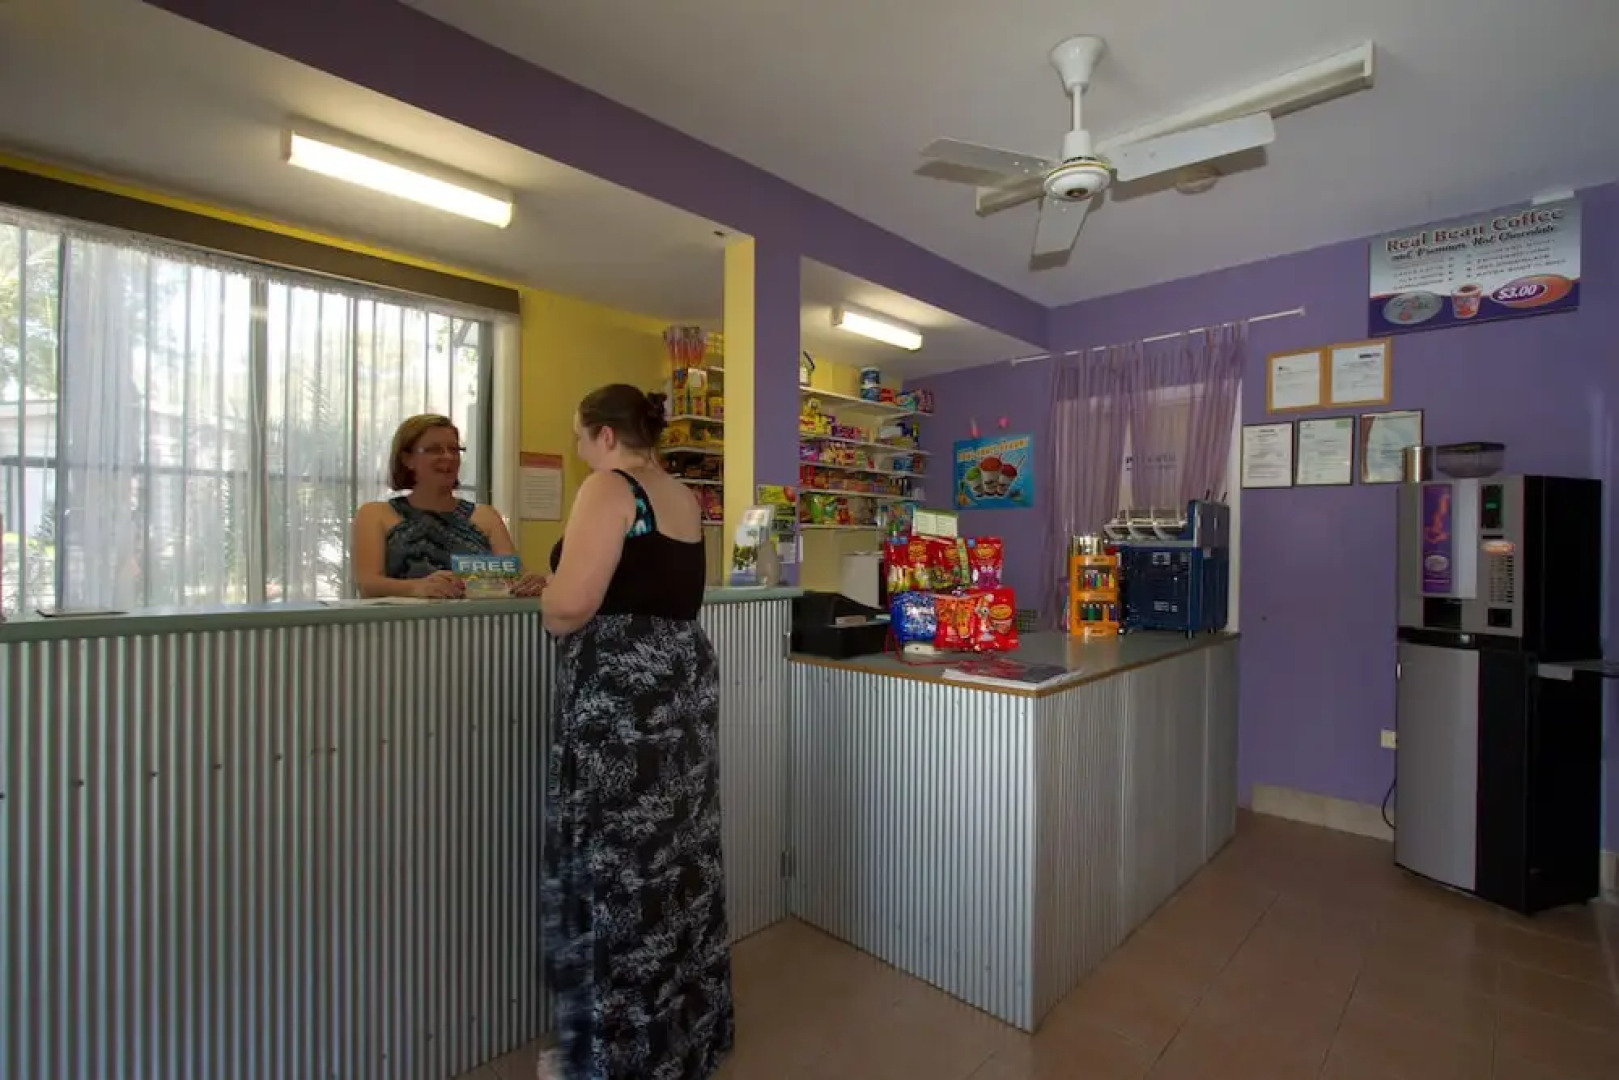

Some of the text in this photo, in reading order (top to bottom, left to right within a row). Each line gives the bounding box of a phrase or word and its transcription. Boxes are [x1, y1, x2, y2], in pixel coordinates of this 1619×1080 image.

[1387, 209, 1565, 252] Real Bean Coffee
[1497, 284, 1538, 300] $3.00
[457, 560, 516, 571] FREE
